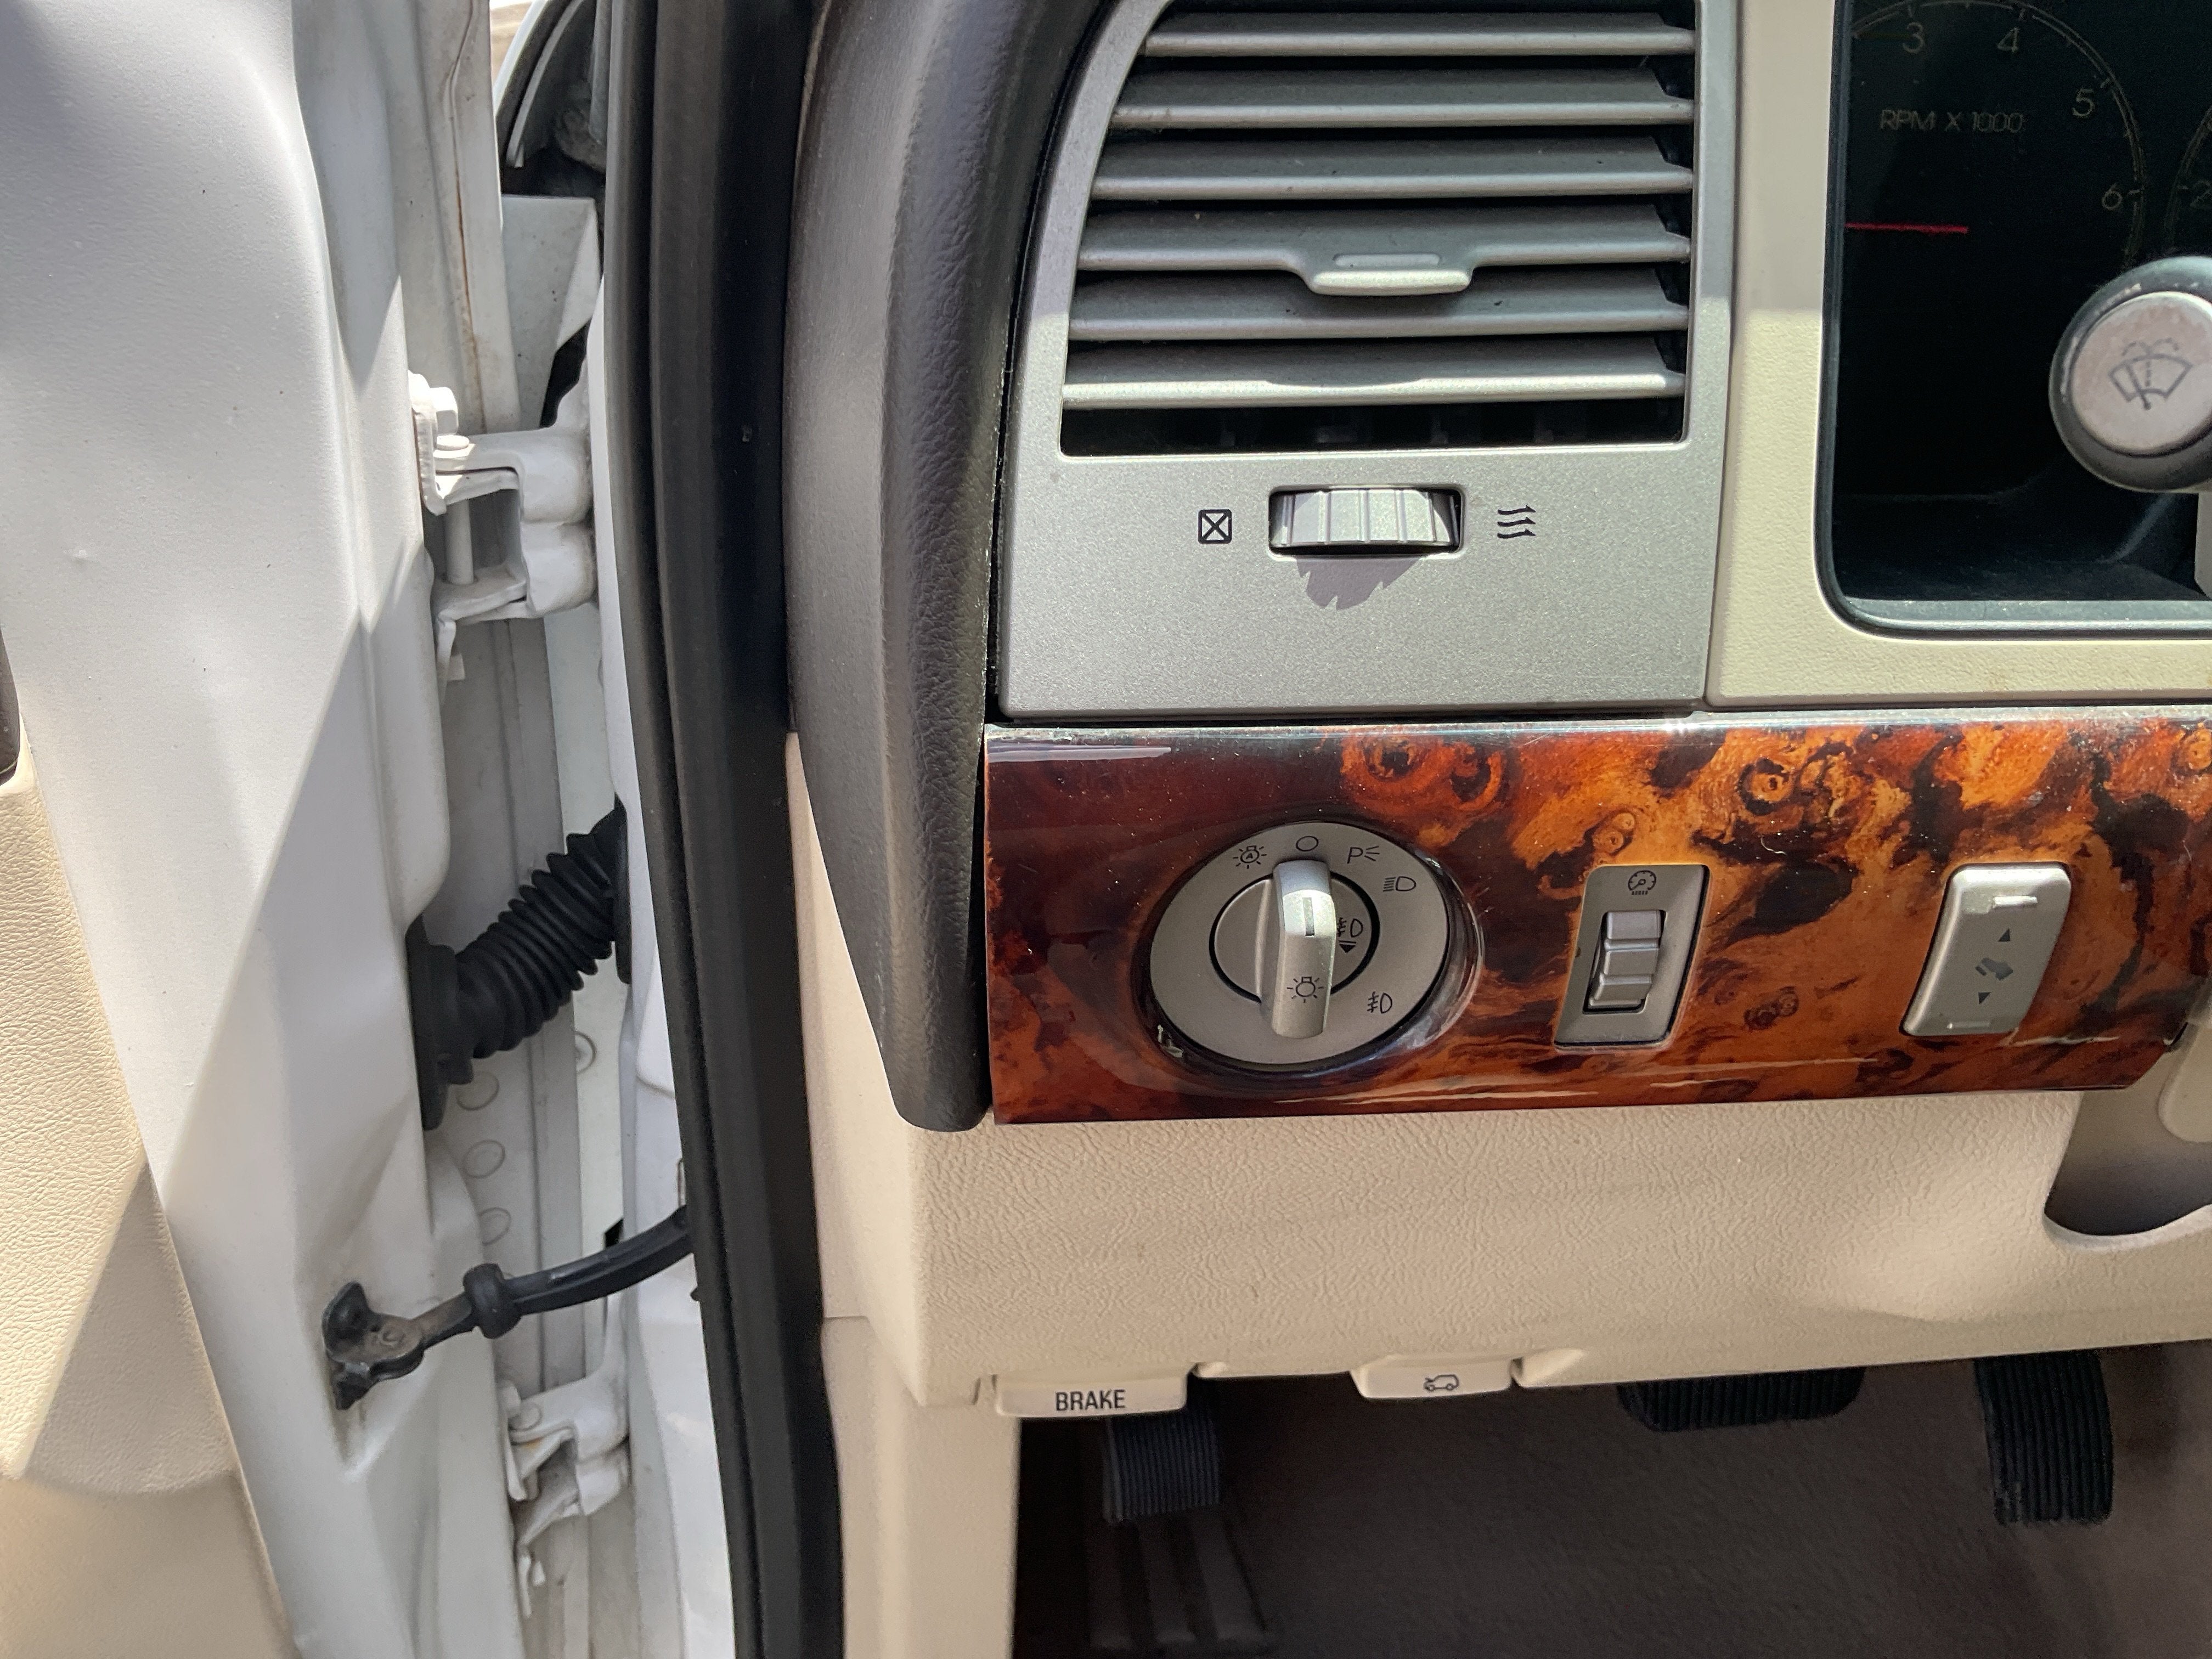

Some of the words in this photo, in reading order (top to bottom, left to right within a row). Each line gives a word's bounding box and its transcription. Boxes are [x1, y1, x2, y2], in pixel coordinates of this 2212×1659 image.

[1996, 26, 2021, 53] 4
[2072, 87, 2095, 117] 5
[1880, 109, 1936, 131] RPM
[1972, 111, 2024, 133] 1000
[2101, 183, 2123, 211] 6
[1056, 1389, 1125, 1411] BRAKE
